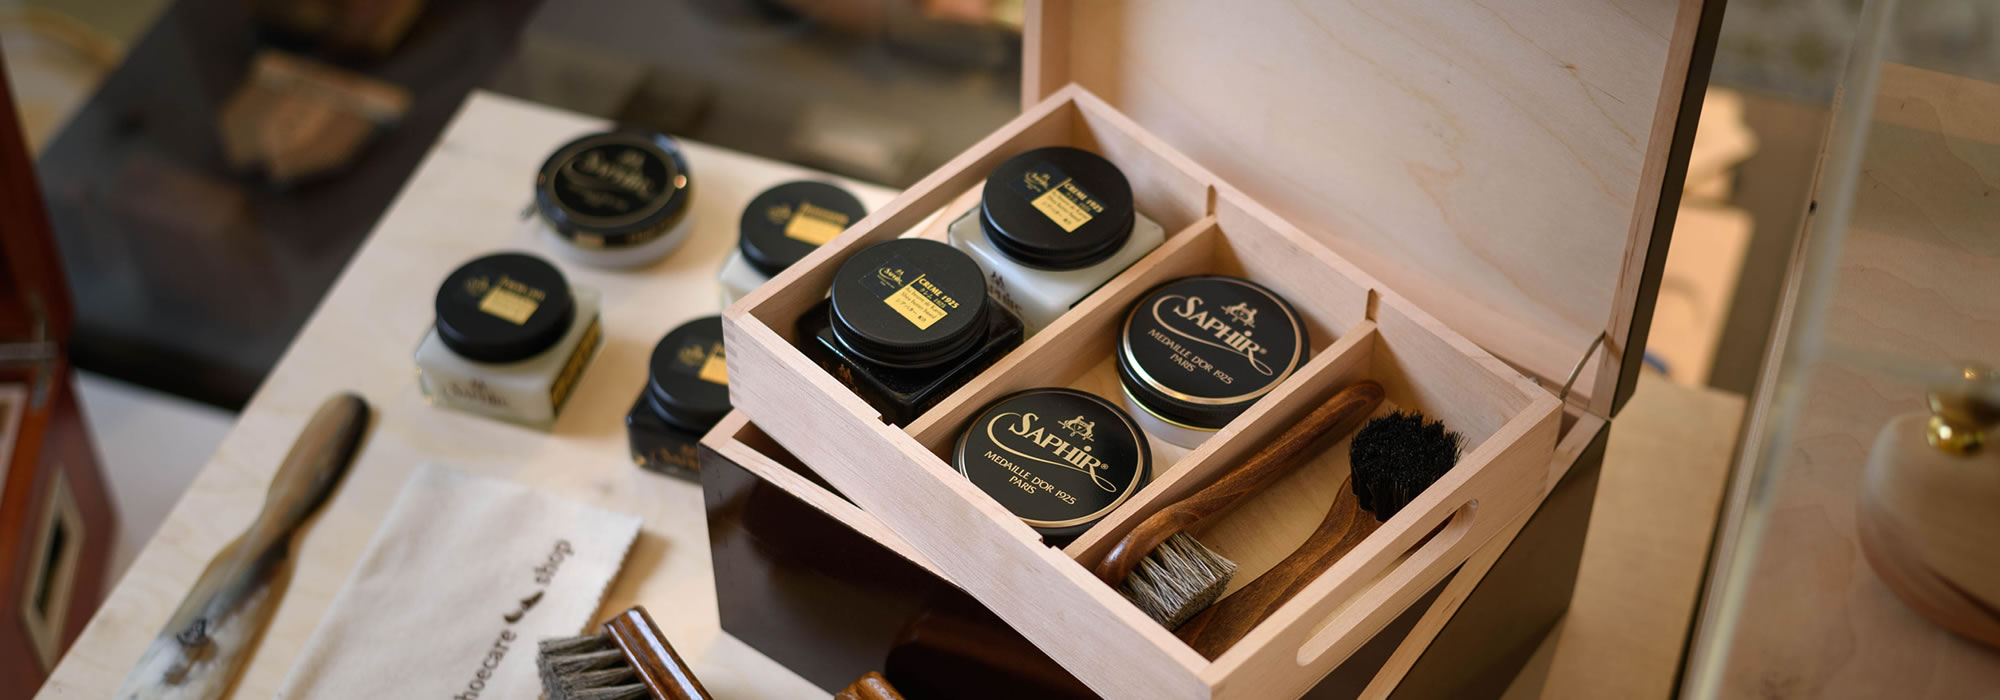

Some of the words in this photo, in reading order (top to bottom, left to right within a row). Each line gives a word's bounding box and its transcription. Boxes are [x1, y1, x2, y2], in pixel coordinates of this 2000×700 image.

[918, 277, 943, 297] CREME
[941, 294, 960, 309] 1925
[1148, 328, 1191, 359] MEDAILLE
[1191, 354, 1213, 372] D'OR
[1213, 369, 1234, 385] 1925
[1170, 353, 1196, 373] PARIS
[984, 450, 1031, 480] MEDAILLE
[1033, 475, 1055, 494] D'OR
[1055, 490, 1077, 505] 1925
[1008, 475, 1037, 495] PARIS
[533, 539, 574, 586] shop
